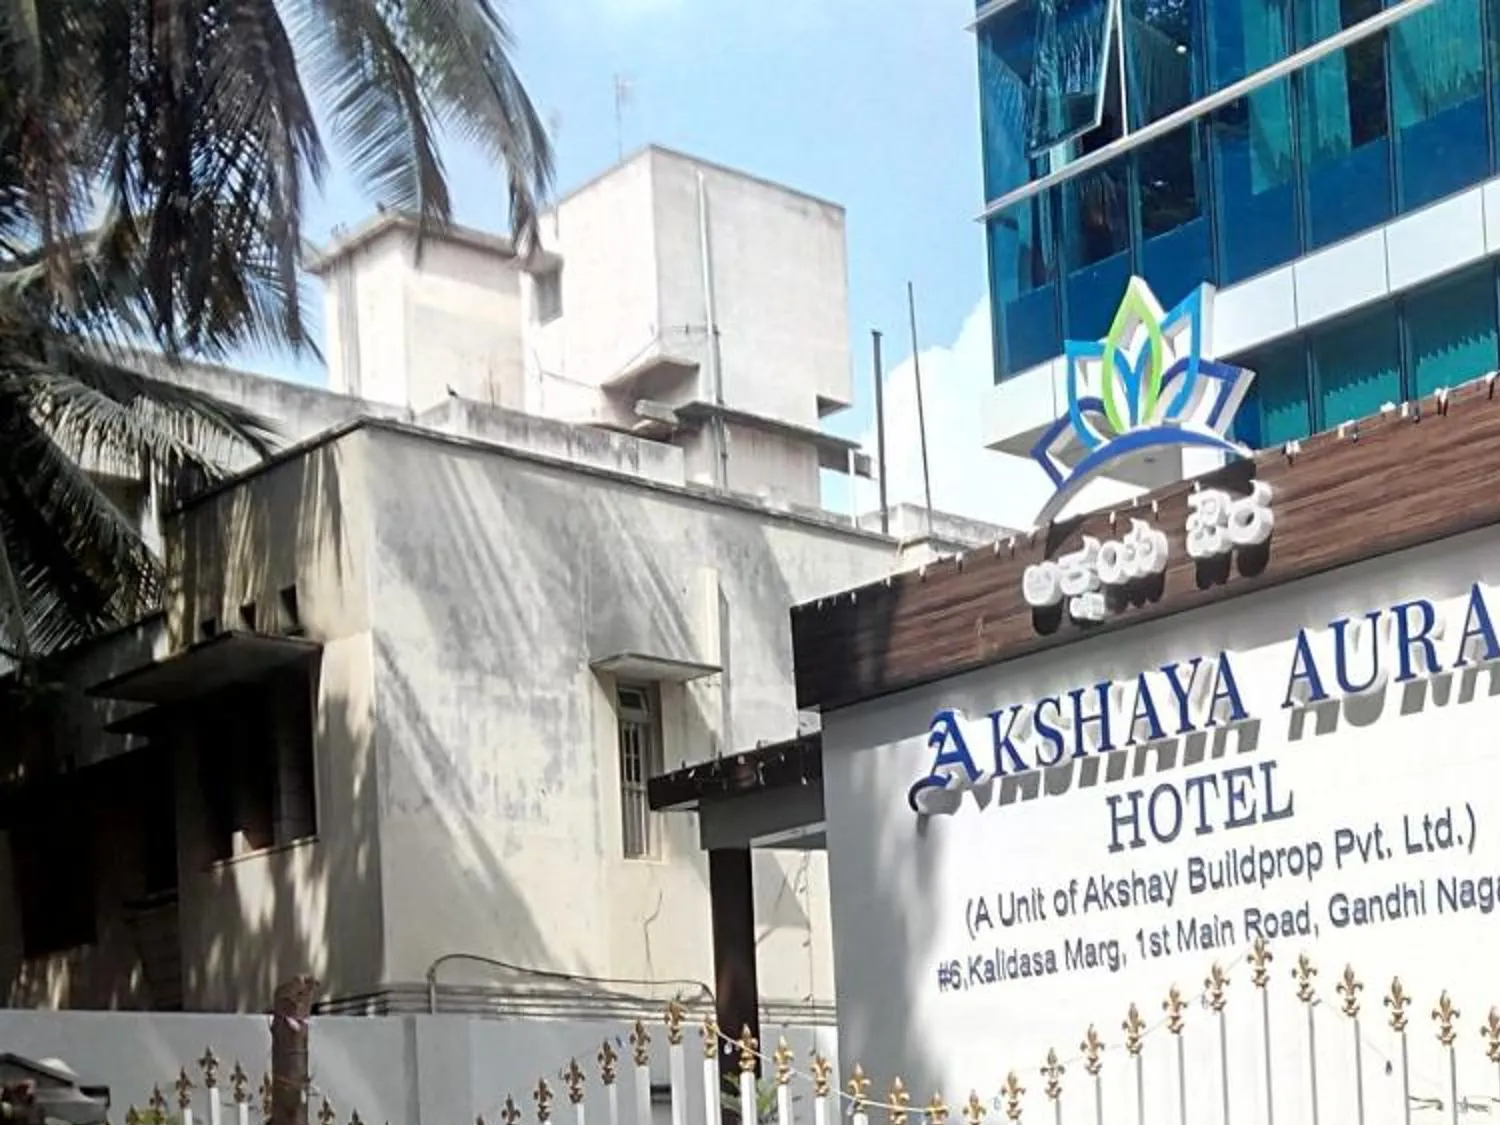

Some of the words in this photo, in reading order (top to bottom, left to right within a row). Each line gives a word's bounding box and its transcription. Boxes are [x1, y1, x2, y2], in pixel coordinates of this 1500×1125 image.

[908, 650, 1249, 812] AKSHAYA
[1105, 760, 1295, 853] HOTEL
[966, 896, 994, 941] (A
[997, 887, 1047, 928] Unit
[1053, 878, 1077, 918] of
[1083, 867, 1178, 914] Akshay
[1187, 839, 1323, 895] Buildprop
[1334, 821, 1393, 870] Pvt.
[1403, 801, 1477, 855] Ltd.)
[1063, 936, 1128, 973] Marg,
[1136, 924, 1171, 960] 1st
[1176, 914, 1236, 952] Main
[1243, 900, 1319, 942] Road,
[1328, 879, 1427, 928] Gandhi
